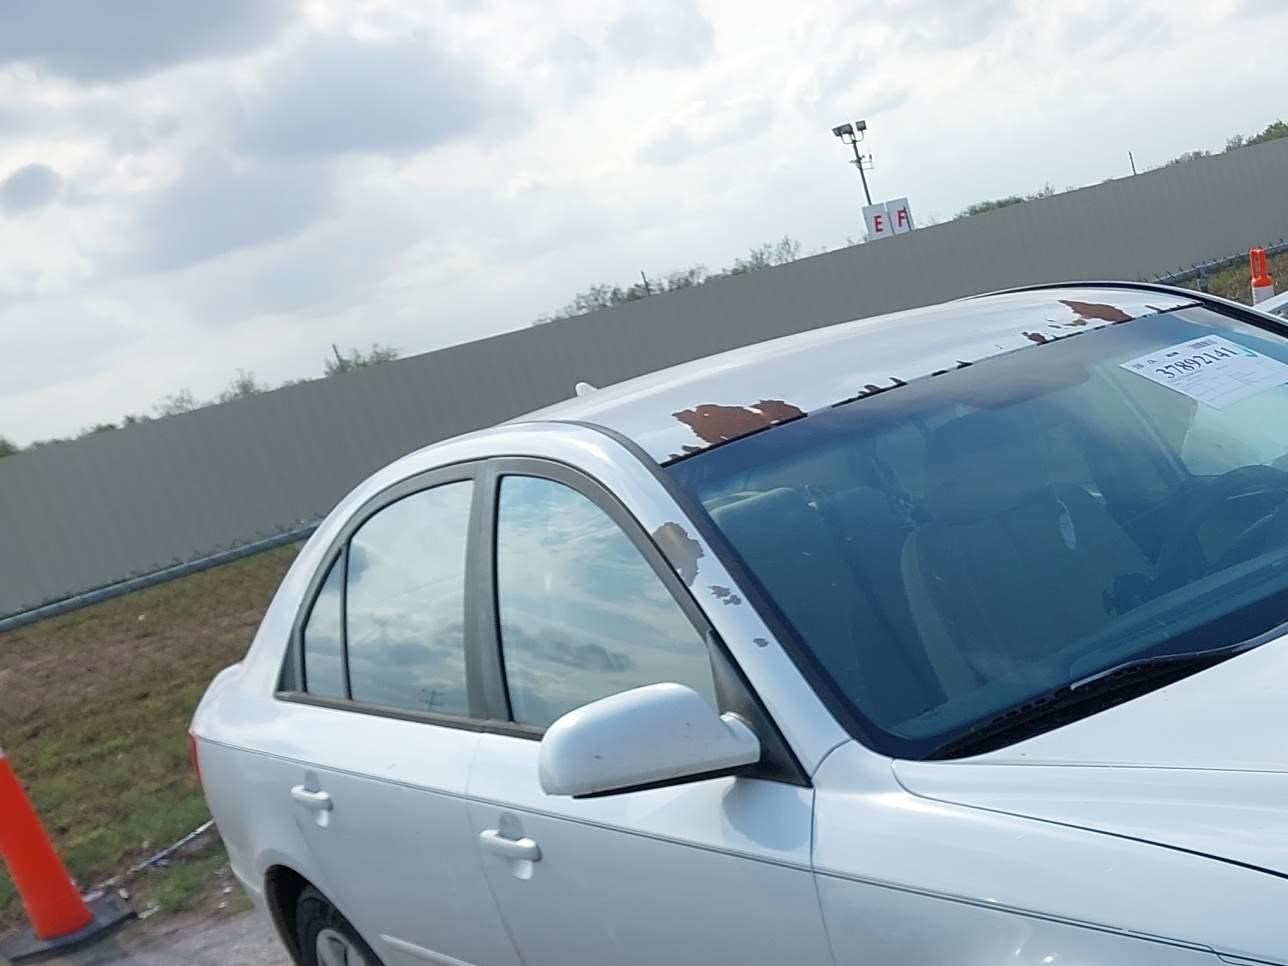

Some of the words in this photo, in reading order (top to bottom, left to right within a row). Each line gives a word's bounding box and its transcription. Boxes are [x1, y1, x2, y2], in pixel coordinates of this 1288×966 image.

[873, 215, 883, 233] E
[897, 209, 906, 228] F
[1155, 346, 1239, 380] 37892141
